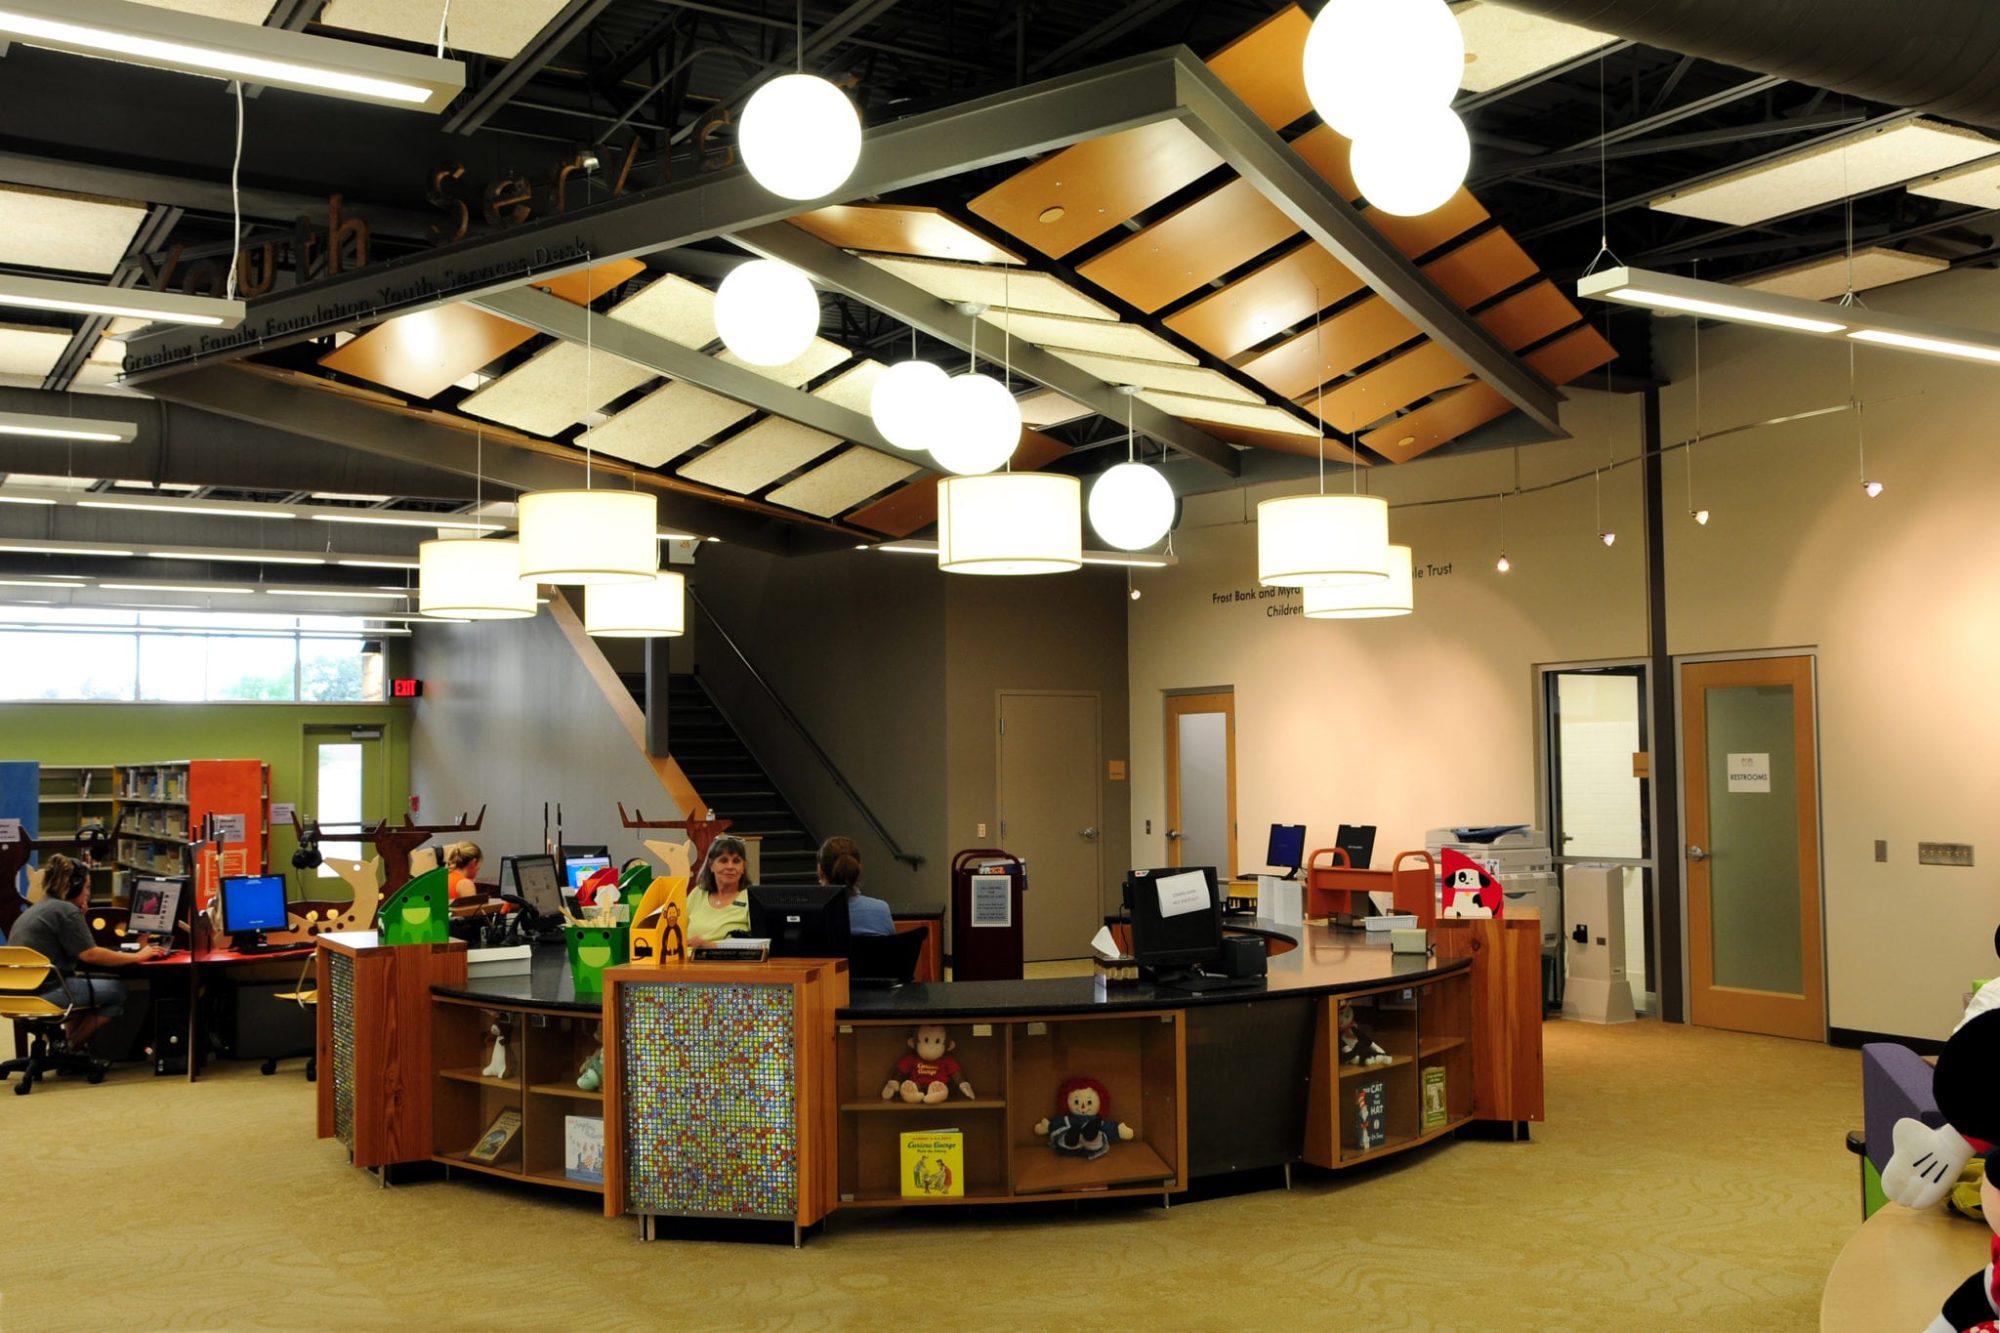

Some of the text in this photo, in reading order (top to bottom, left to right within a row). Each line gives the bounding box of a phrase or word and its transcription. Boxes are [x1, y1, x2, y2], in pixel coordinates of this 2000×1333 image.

[138, 192, 369, 298] Youth
[201, 325, 257, 351] Family
[266, 299, 371, 338] Foundation
[378, 276, 433, 304] Youth
[444, 257, 527, 288] Services
[534, 235, 587, 266] Desk
[1212, 592, 1233, 605] Frost
[1234, 588, 1256, 602] Bank
[1258, 585, 1276, 598] and
[1427, 562, 1452, 577] Trust
[394, 679, 417, 697] EXIT
[1730, 773, 1768, 781] RESTROOMS
[1370, 1084, 1383, 1093] CAT
[1370, 1105, 1383, 1115] HAT
